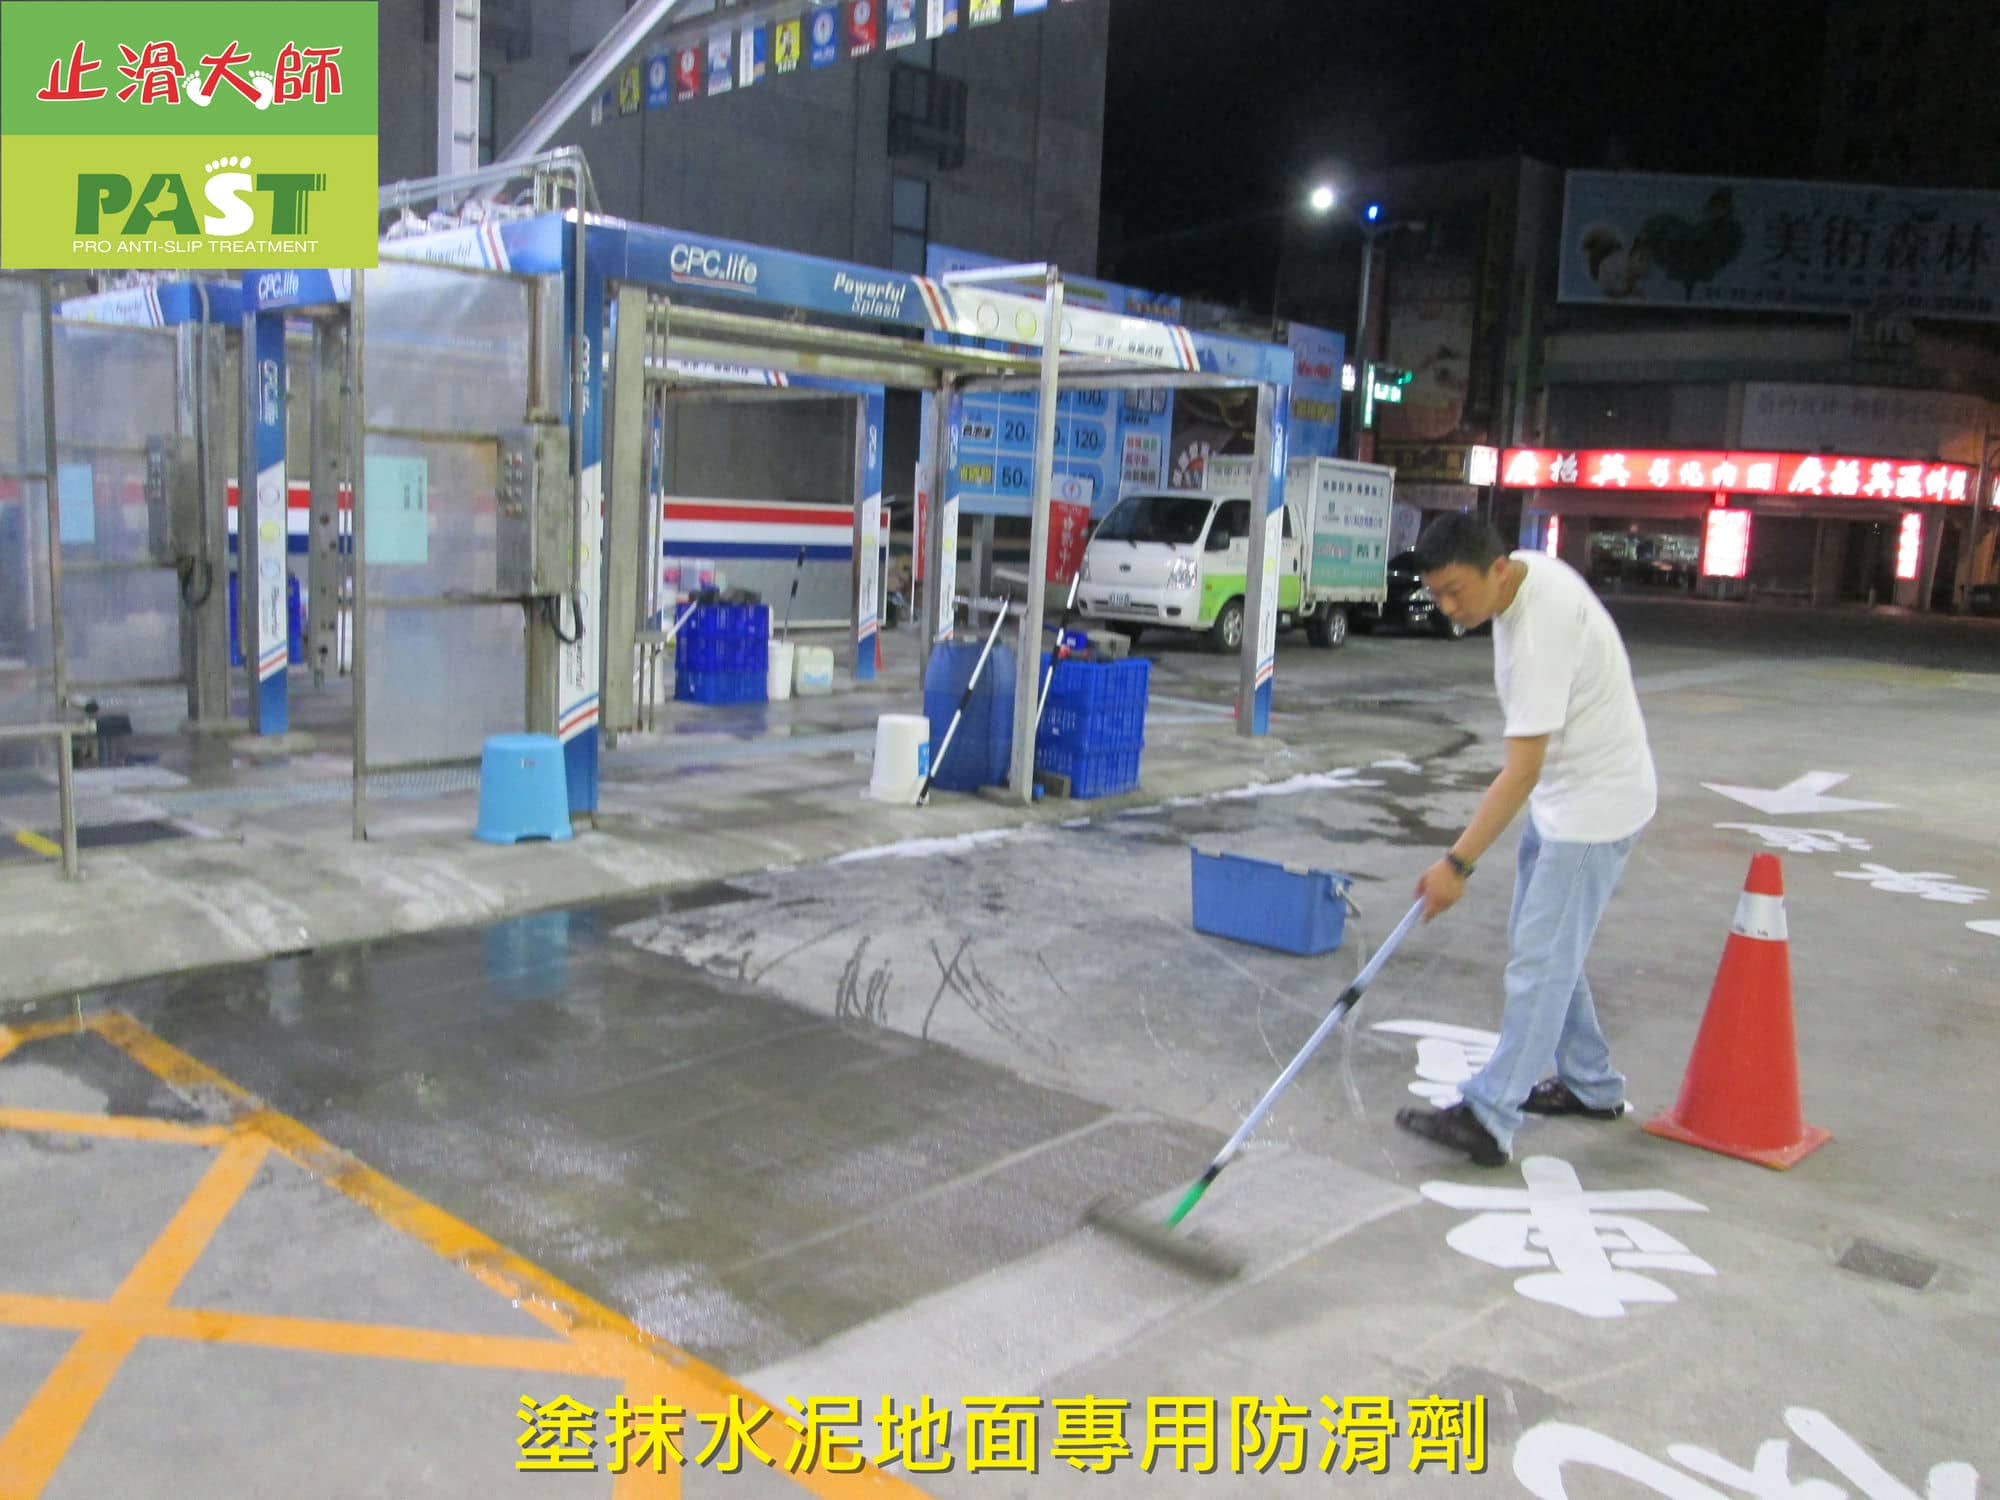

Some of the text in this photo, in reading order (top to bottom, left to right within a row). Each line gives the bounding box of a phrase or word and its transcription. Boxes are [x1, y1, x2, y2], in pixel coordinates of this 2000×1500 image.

[669, 243, 758, 285] CPC.life
[258, 271, 299, 301] CPC.life
[833, 271, 906, 303] Powerful
